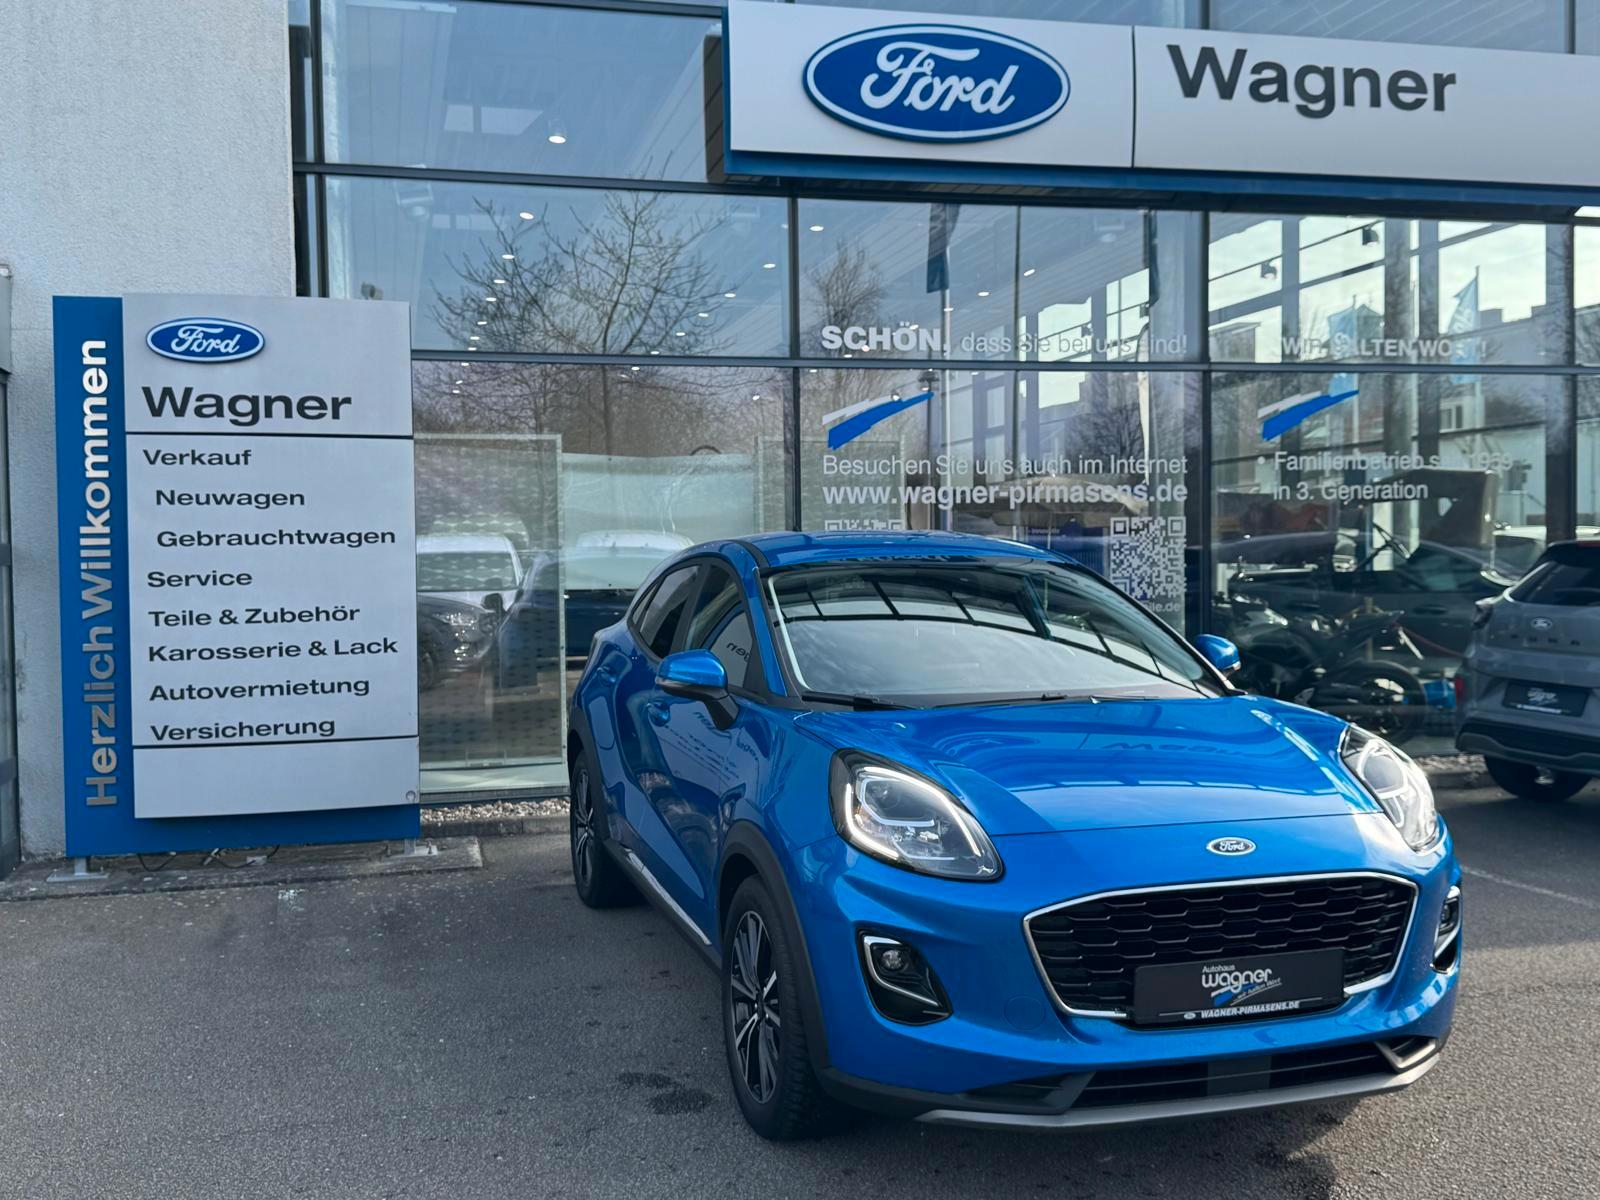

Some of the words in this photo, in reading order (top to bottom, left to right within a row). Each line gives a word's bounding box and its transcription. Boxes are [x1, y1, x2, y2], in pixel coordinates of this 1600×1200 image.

[860, 40, 1018, 115] Ford
[1167, 45, 1457, 118] Wagner
[171, 325, 240, 354] Ford
[961, 331, 1012, 352] dass
[1018, 333, 1050, 353] Sie
[1058, 333, 1094, 353] bei
[1139, 334, 1188, 354] ind!
[1330, 338, 1412, 357] LTEN
[1418, 338, 1487, 358] WO!
[142, 386, 352, 427] Wagner
[143, 448, 252, 466] Verkauf
[823, 455, 931, 475] Besuchen
[936, 456, 968, 475] Sie
[976, 461, 1012, 475] uns
[1020, 455, 1070, 475] auch
[1078, 455, 1105, 474] im
[1110, 455, 1188, 474] Internet
[1274, 449, 1425, 471] Familienbetrieb
[79, 339, 113, 620] Willkommen
[1296, 482, 1315, 501] 3.
[1321, 480, 1429, 501] Generation
[156, 490, 305, 511] Neuwagen
[823, 478, 1188, 511] www.wagner-pirmasens.de
[157, 528, 396, 552] Gebrauchtwagen
[147, 569, 253, 588] Service
[148, 610, 212, 628] Teile
[218, 609, 239, 625] &
[245, 605, 361, 624] Zubehör
[148, 641, 302, 662] Karosserie
[308, 640, 328, 657] &
[334, 637, 398, 656] Lack
[149, 677, 370, 701] Autovermietung
[83, 625, 118, 807] Herzlich
[150, 717, 336, 741] Versicherung
[1201, 968, 1272, 994] wagner
[1200, 1000, 1301, 1019] WAGNER-PIRMASENS.DE
